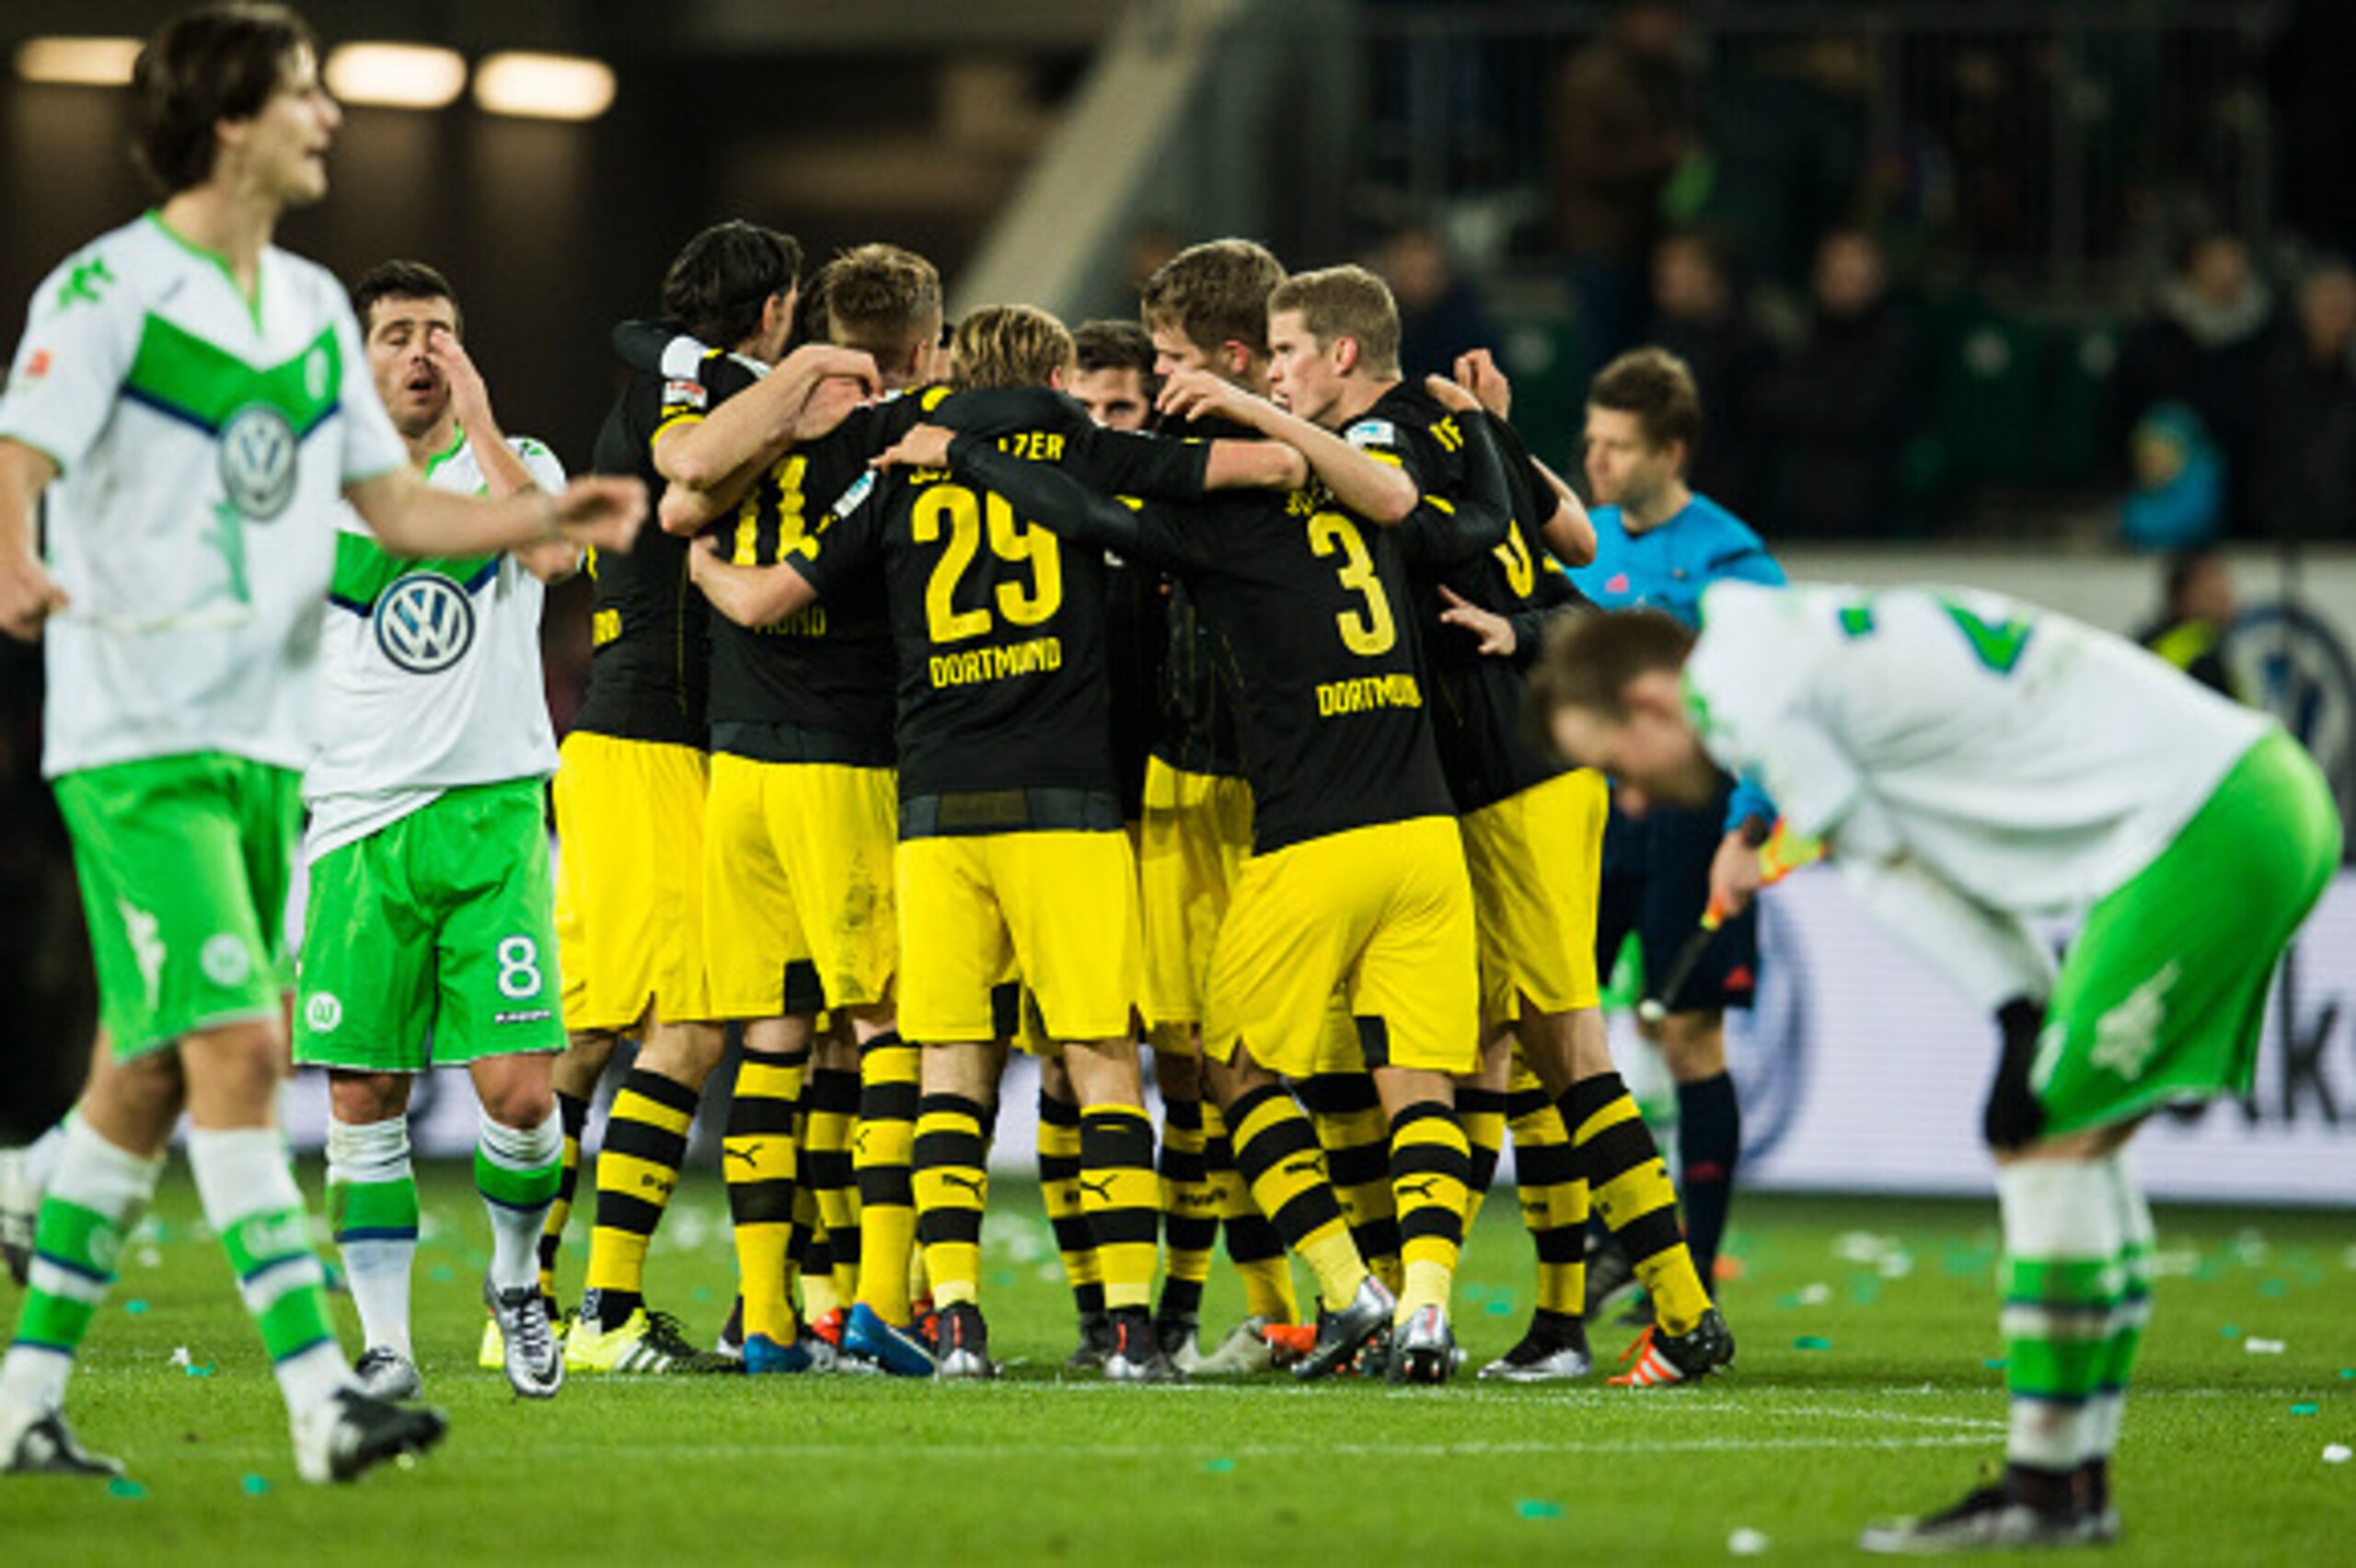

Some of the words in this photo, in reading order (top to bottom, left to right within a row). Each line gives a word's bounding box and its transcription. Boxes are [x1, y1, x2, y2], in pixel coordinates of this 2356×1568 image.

[909, 481, 1062, 644] 29
[1307, 511, 1396, 656] 3
[929, 637, 1062, 689] DORTMUND
[498, 936, 542, 998] 8
